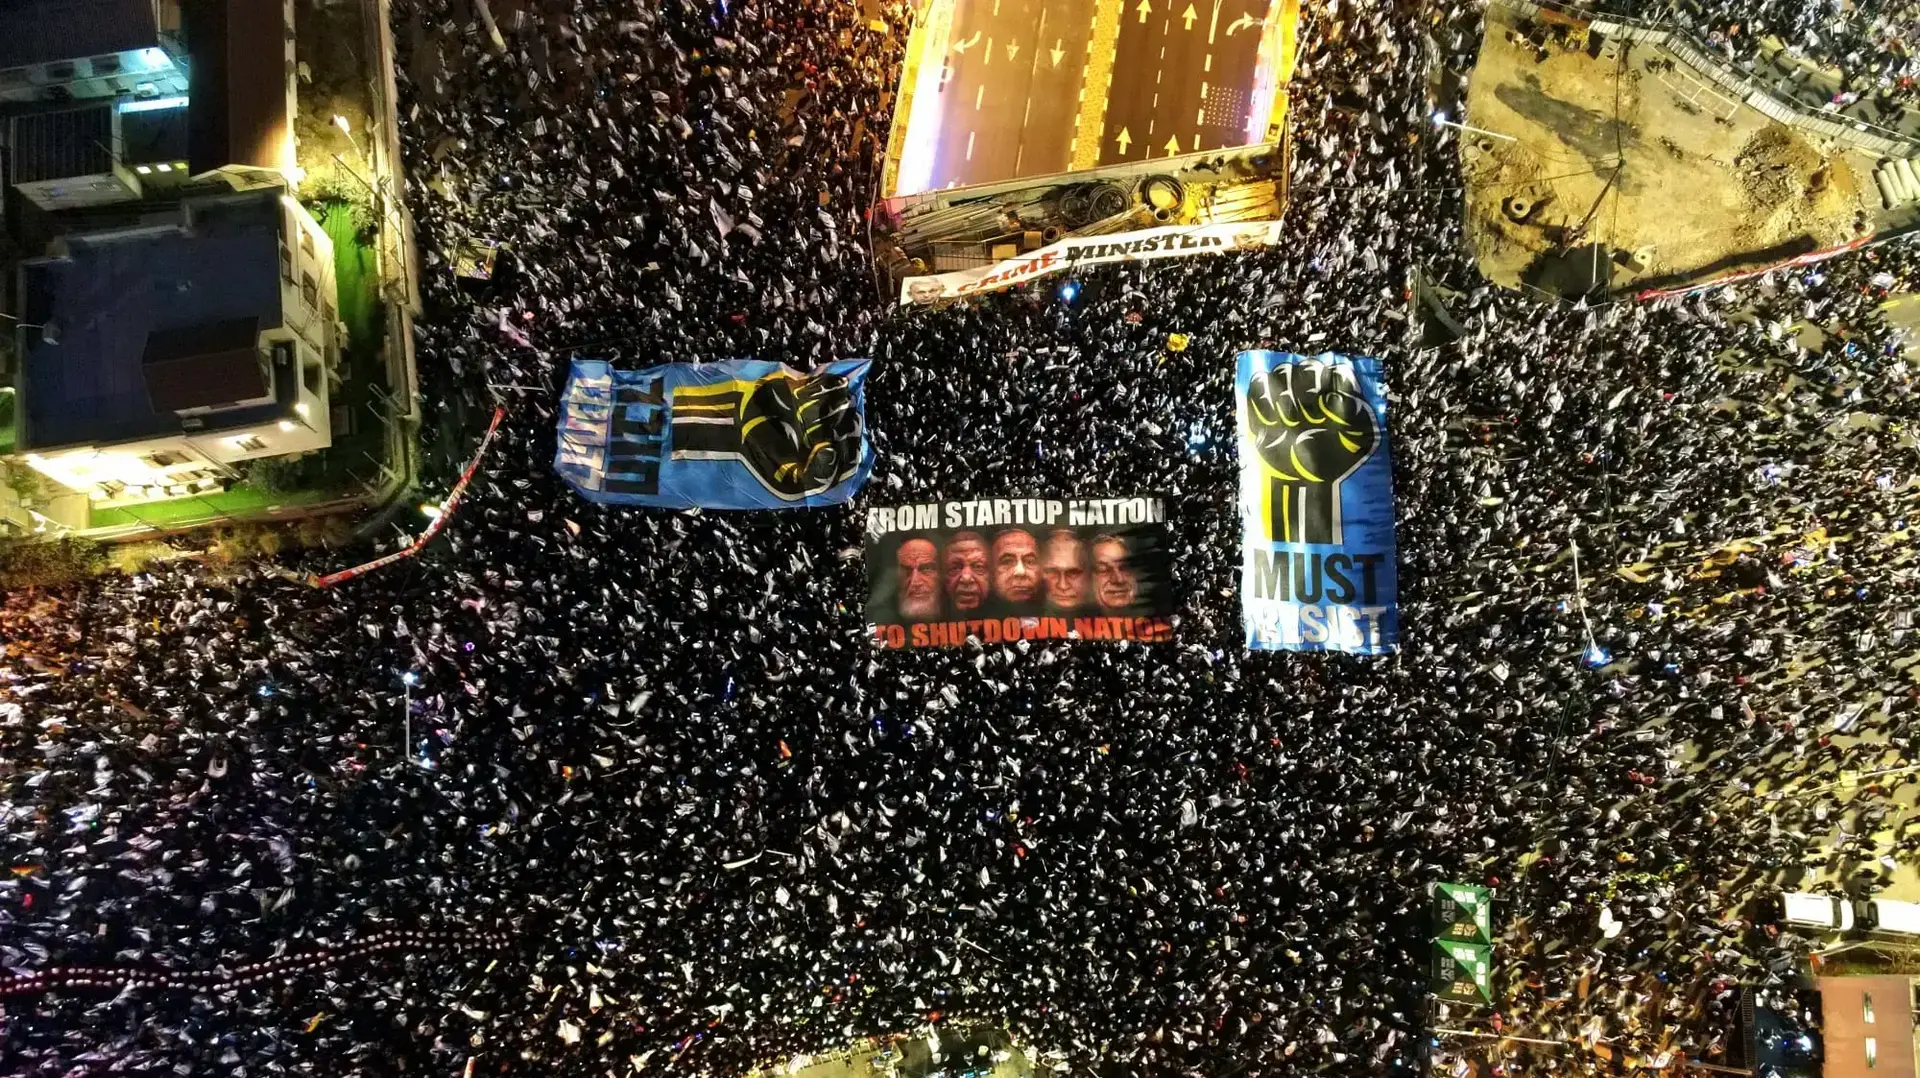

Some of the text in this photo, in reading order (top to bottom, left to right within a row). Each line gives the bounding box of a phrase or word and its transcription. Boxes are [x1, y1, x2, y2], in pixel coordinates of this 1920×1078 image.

[957, 250, 1058, 291] CRIME
[945, 499, 1063, 529] STARTUP
[1069, 498, 1165, 526] NATION
[1253, 548, 1385, 605] MUST
[876, 624, 905, 649] TO
[912, 616, 1068, 648] SHUTDOWN
[1252, 603, 1387, 650] RESIST
